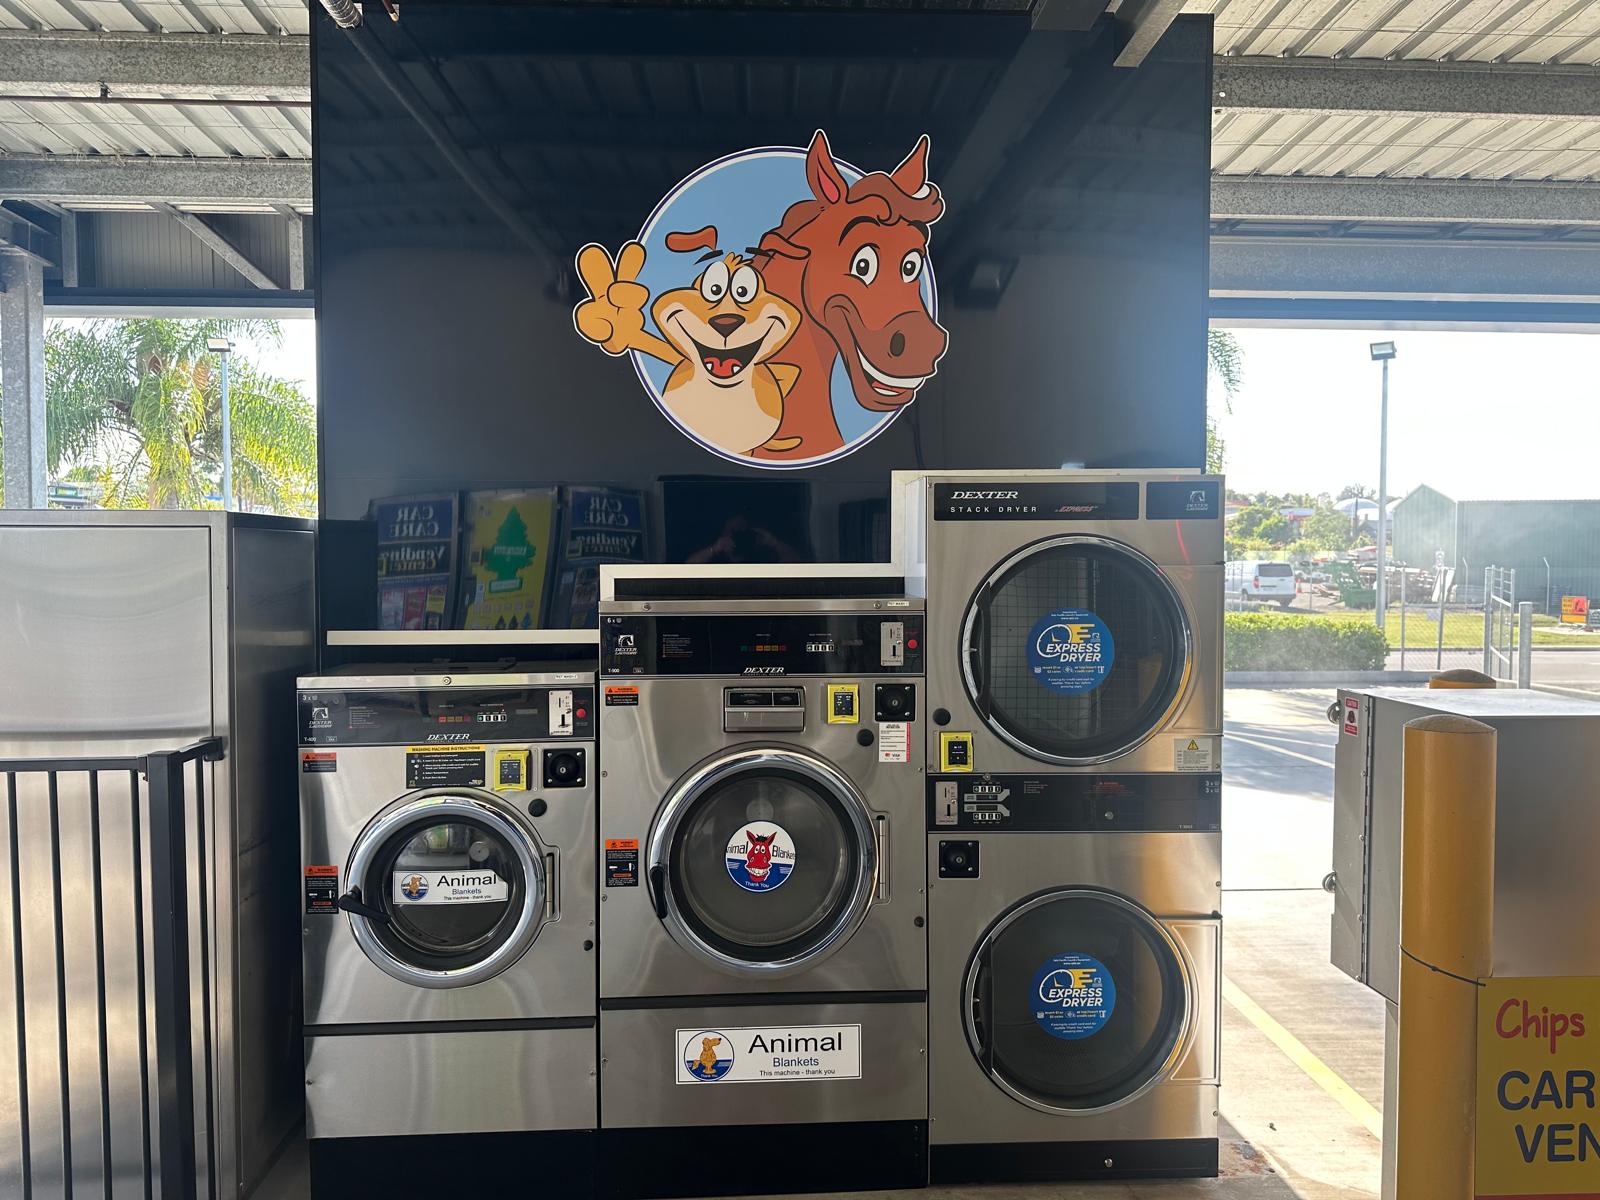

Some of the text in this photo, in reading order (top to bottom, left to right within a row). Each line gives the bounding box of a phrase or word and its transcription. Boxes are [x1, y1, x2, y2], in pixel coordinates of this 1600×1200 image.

[951, 491, 1019, 499] DEXTER
[1045, 643, 1101, 653] EXPRESS
[1060, 653, 1102, 662] DRYER
[427, 733, 471, 741] DEXTER
[726, 841, 749, 854] nimal
[437, 874, 497, 887] Animal
[1048, 988, 1103, 998] EXPRESS
[1062, 998, 1103, 1007] DRYER
[1496, 998, 1585, 1054] Chips
[748, 1032, 842, 1054] Animal
[773, 1057, 819, 1068] Blankets
[1497, 1070, 1595, 1111] CAR
[1515, 1122, 1600, 1163] VEN
